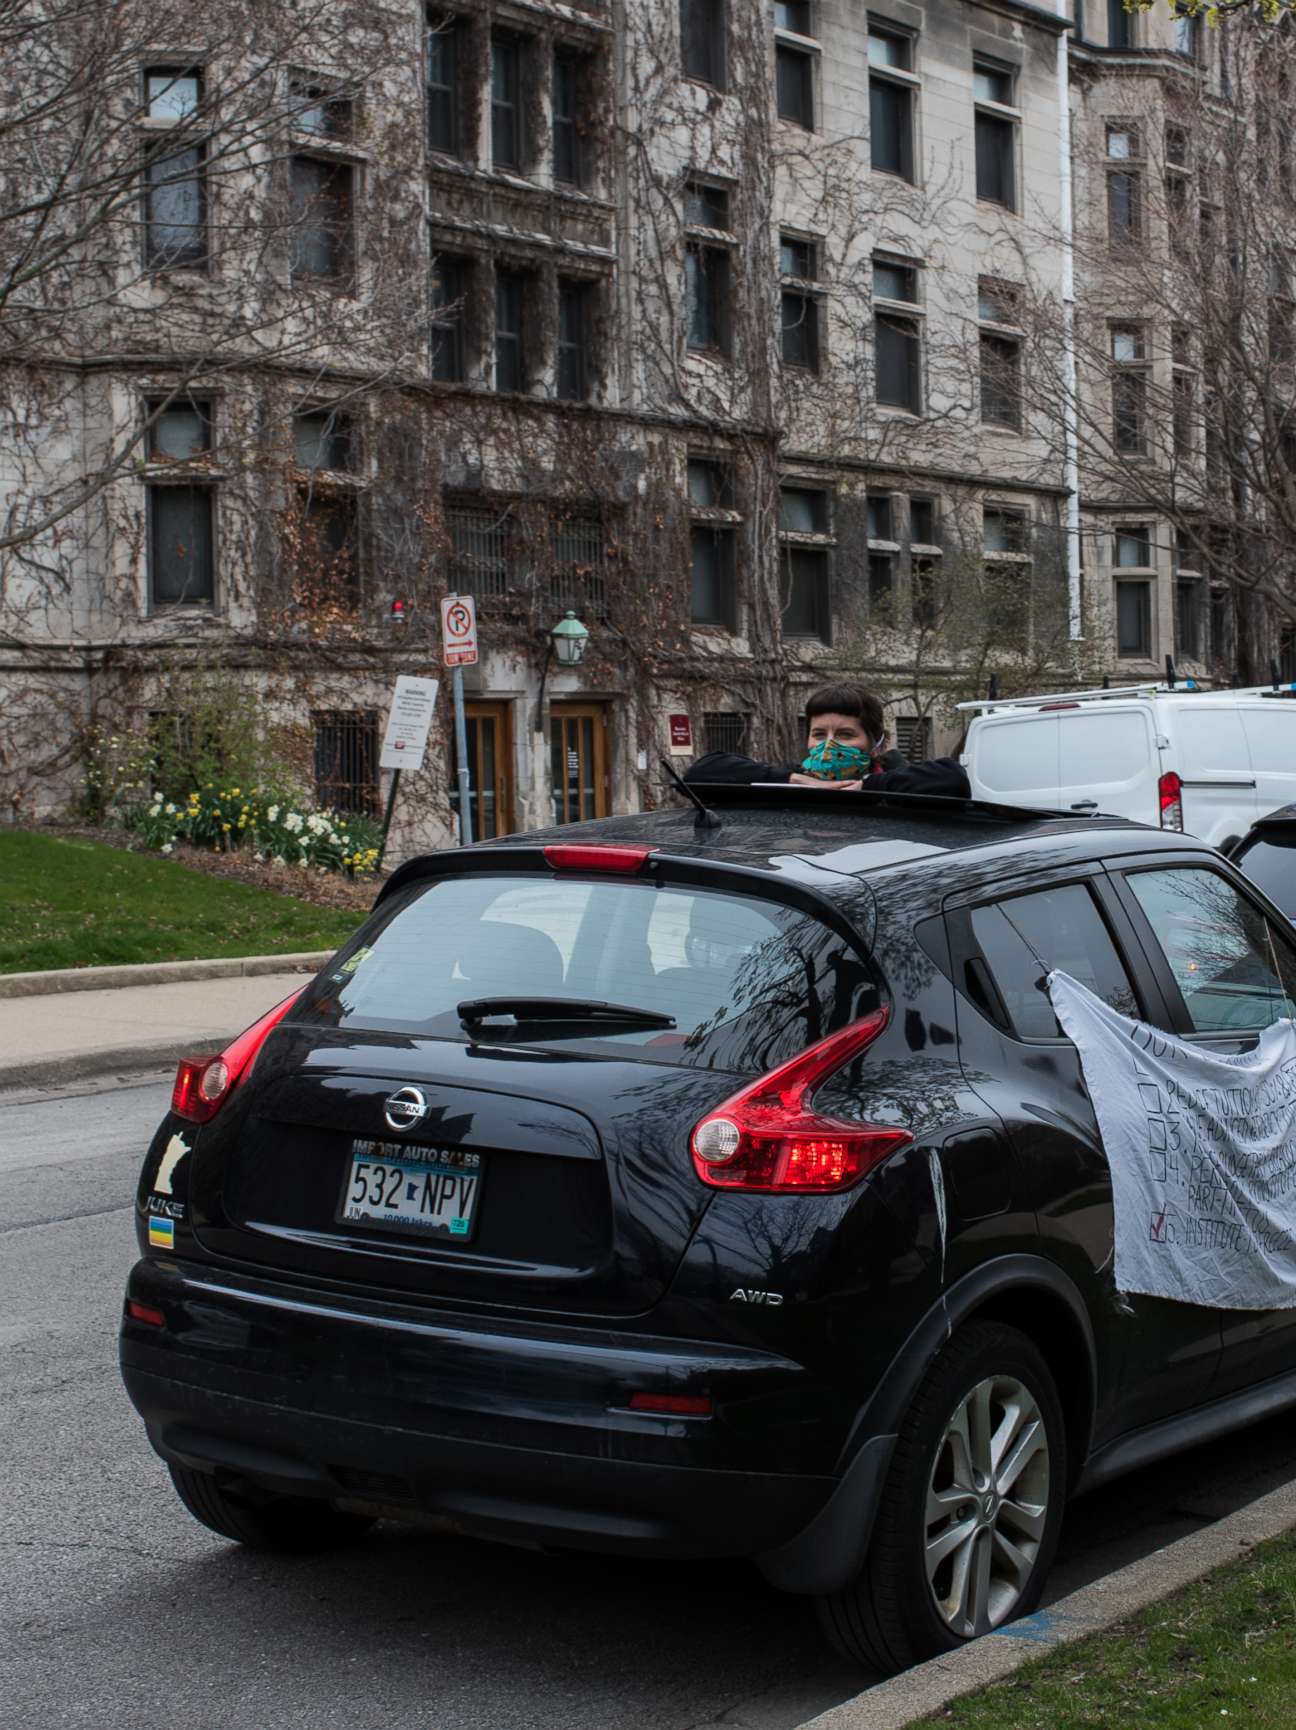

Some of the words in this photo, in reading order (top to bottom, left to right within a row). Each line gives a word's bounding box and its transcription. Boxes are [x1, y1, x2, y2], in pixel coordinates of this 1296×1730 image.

[403, 1145, 438, 1162] AUTO
[351, 1163, 404, 1209] 532
[419, 1171, 475, 1219] NPV
[141, 1196, 185, 1218] JUKE
[729, 1288, 783, 1304] AWD
